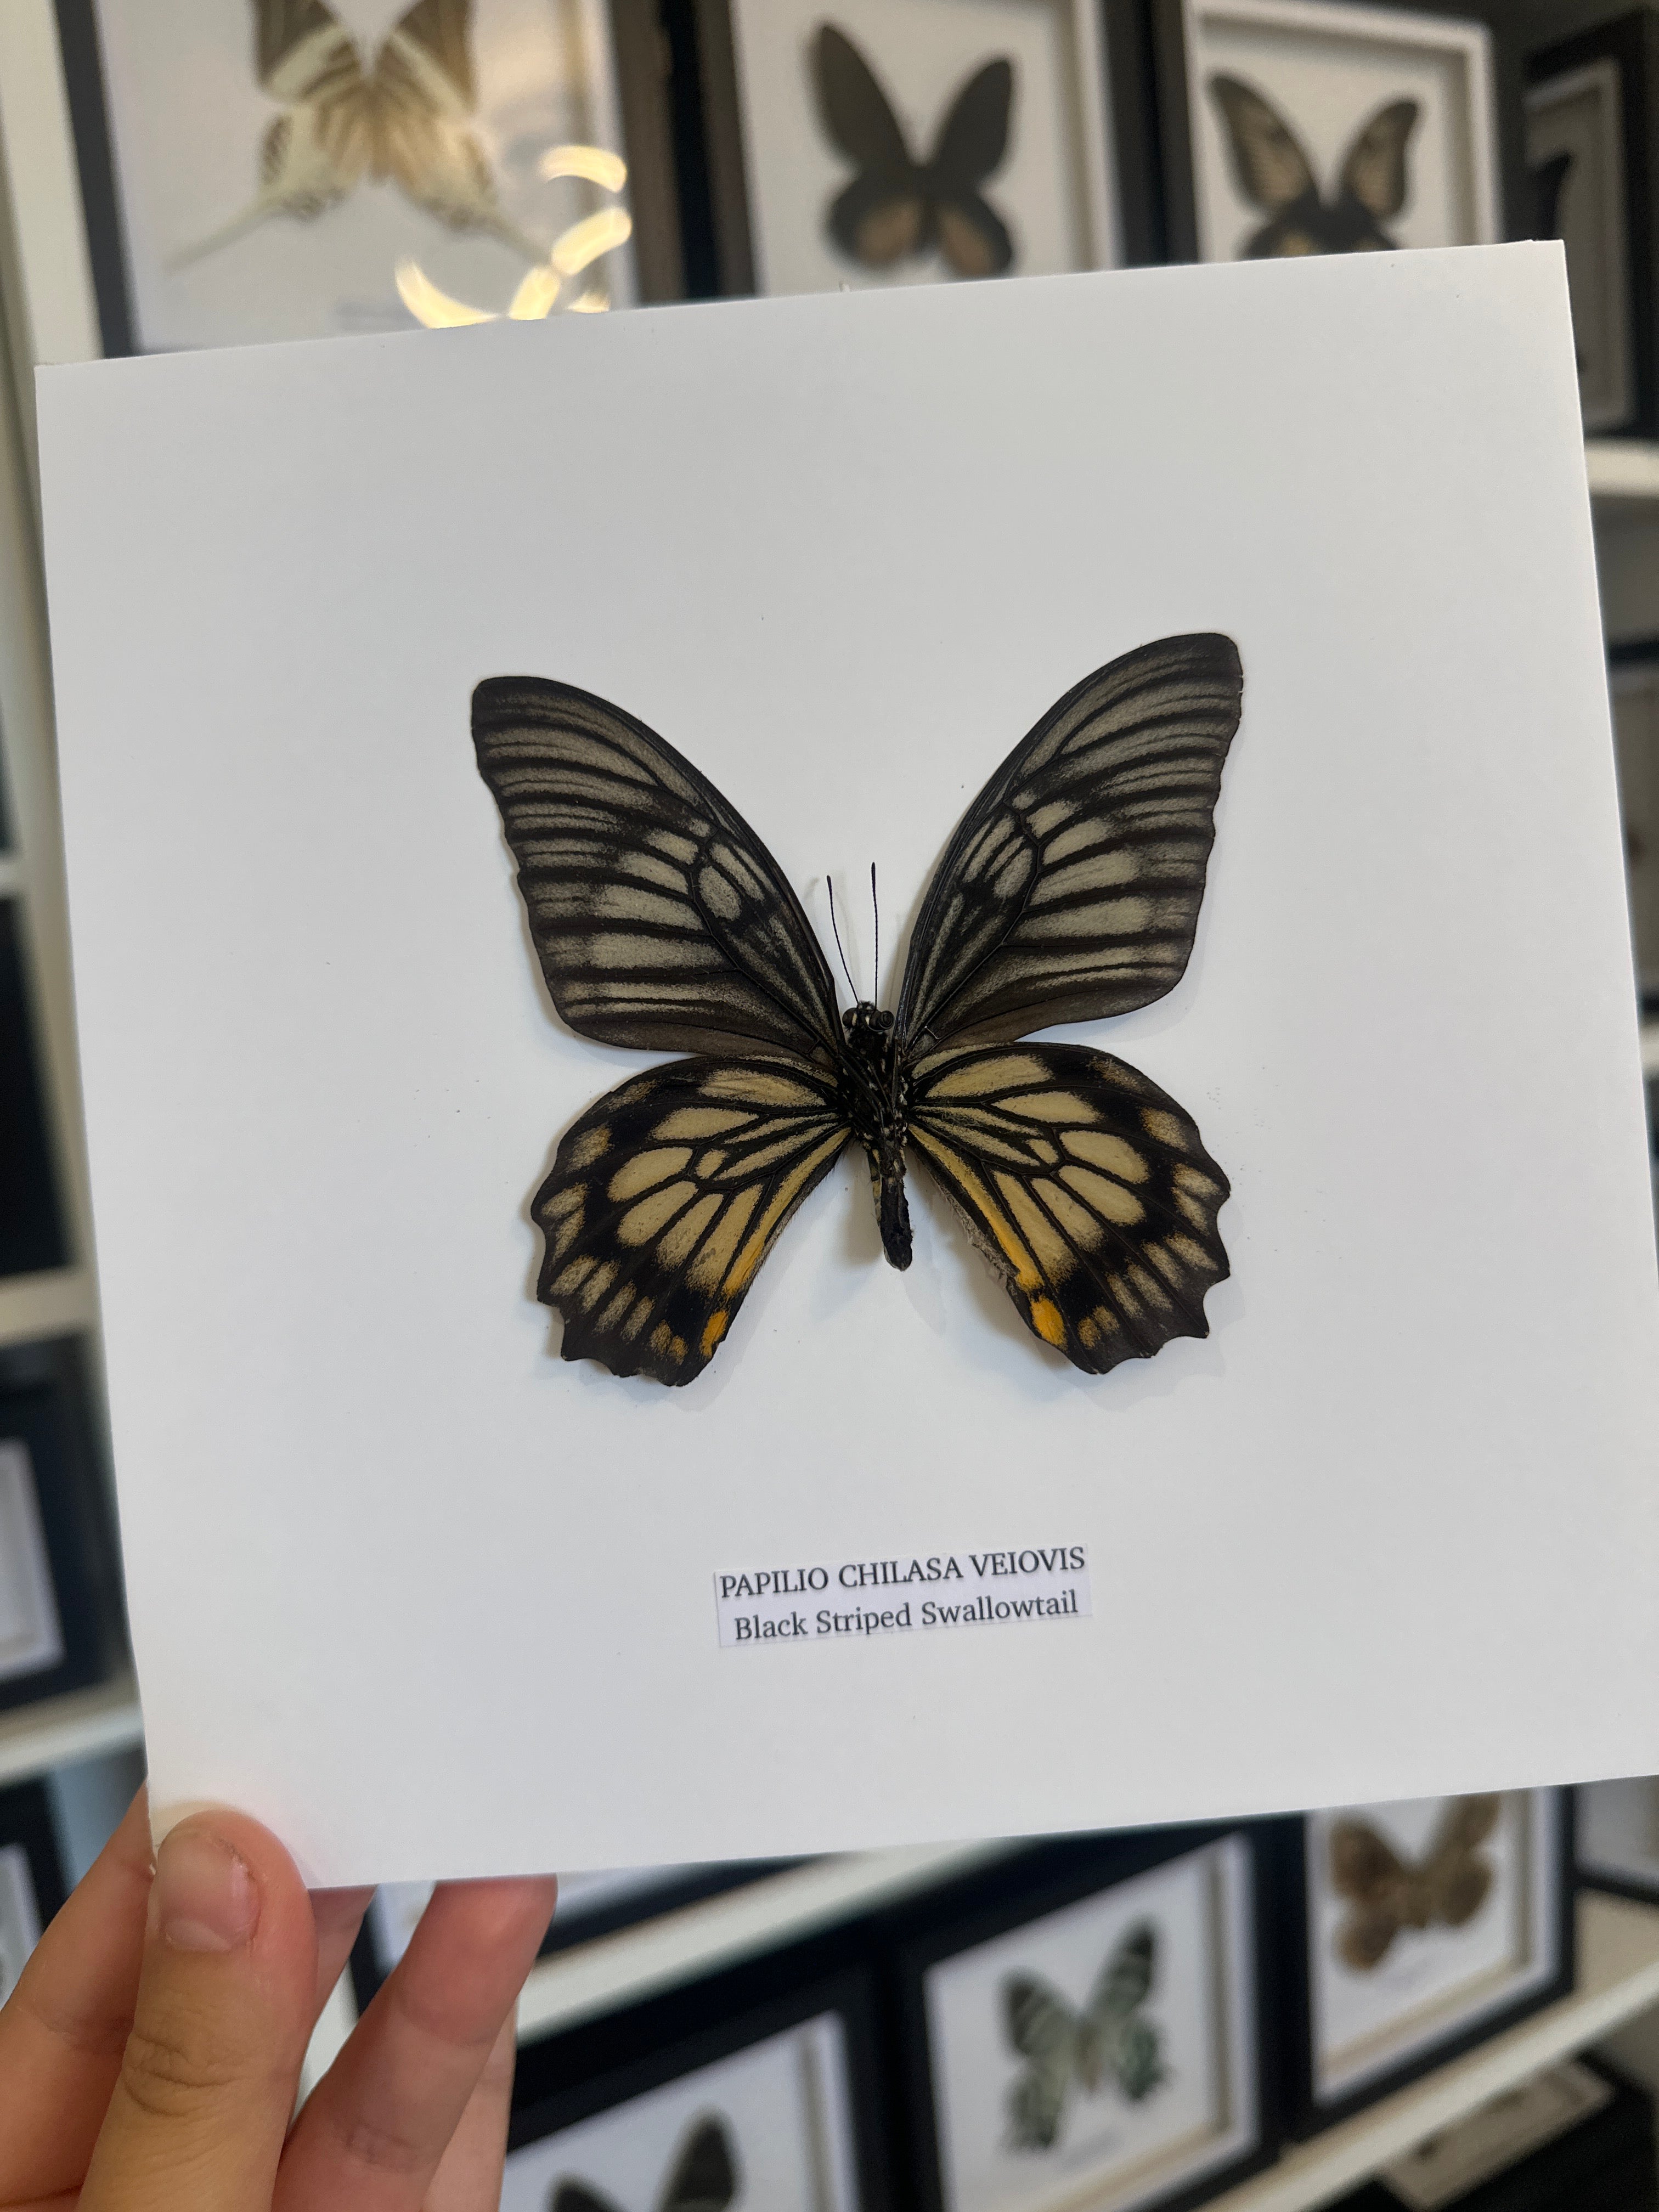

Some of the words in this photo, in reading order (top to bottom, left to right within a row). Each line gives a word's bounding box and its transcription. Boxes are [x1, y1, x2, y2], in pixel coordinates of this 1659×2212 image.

[720, 1567, 829, 1599] PAPILIO
[838, 1556, 964, 1588] CHILASA
[968, 1547, 1085, 1577] VEIOVIS
[734, 1611, 809, 1641] Black
[816, 1602, 912, 1635] Striped
[921, 1589, 1079, 1626] Swallowtail
